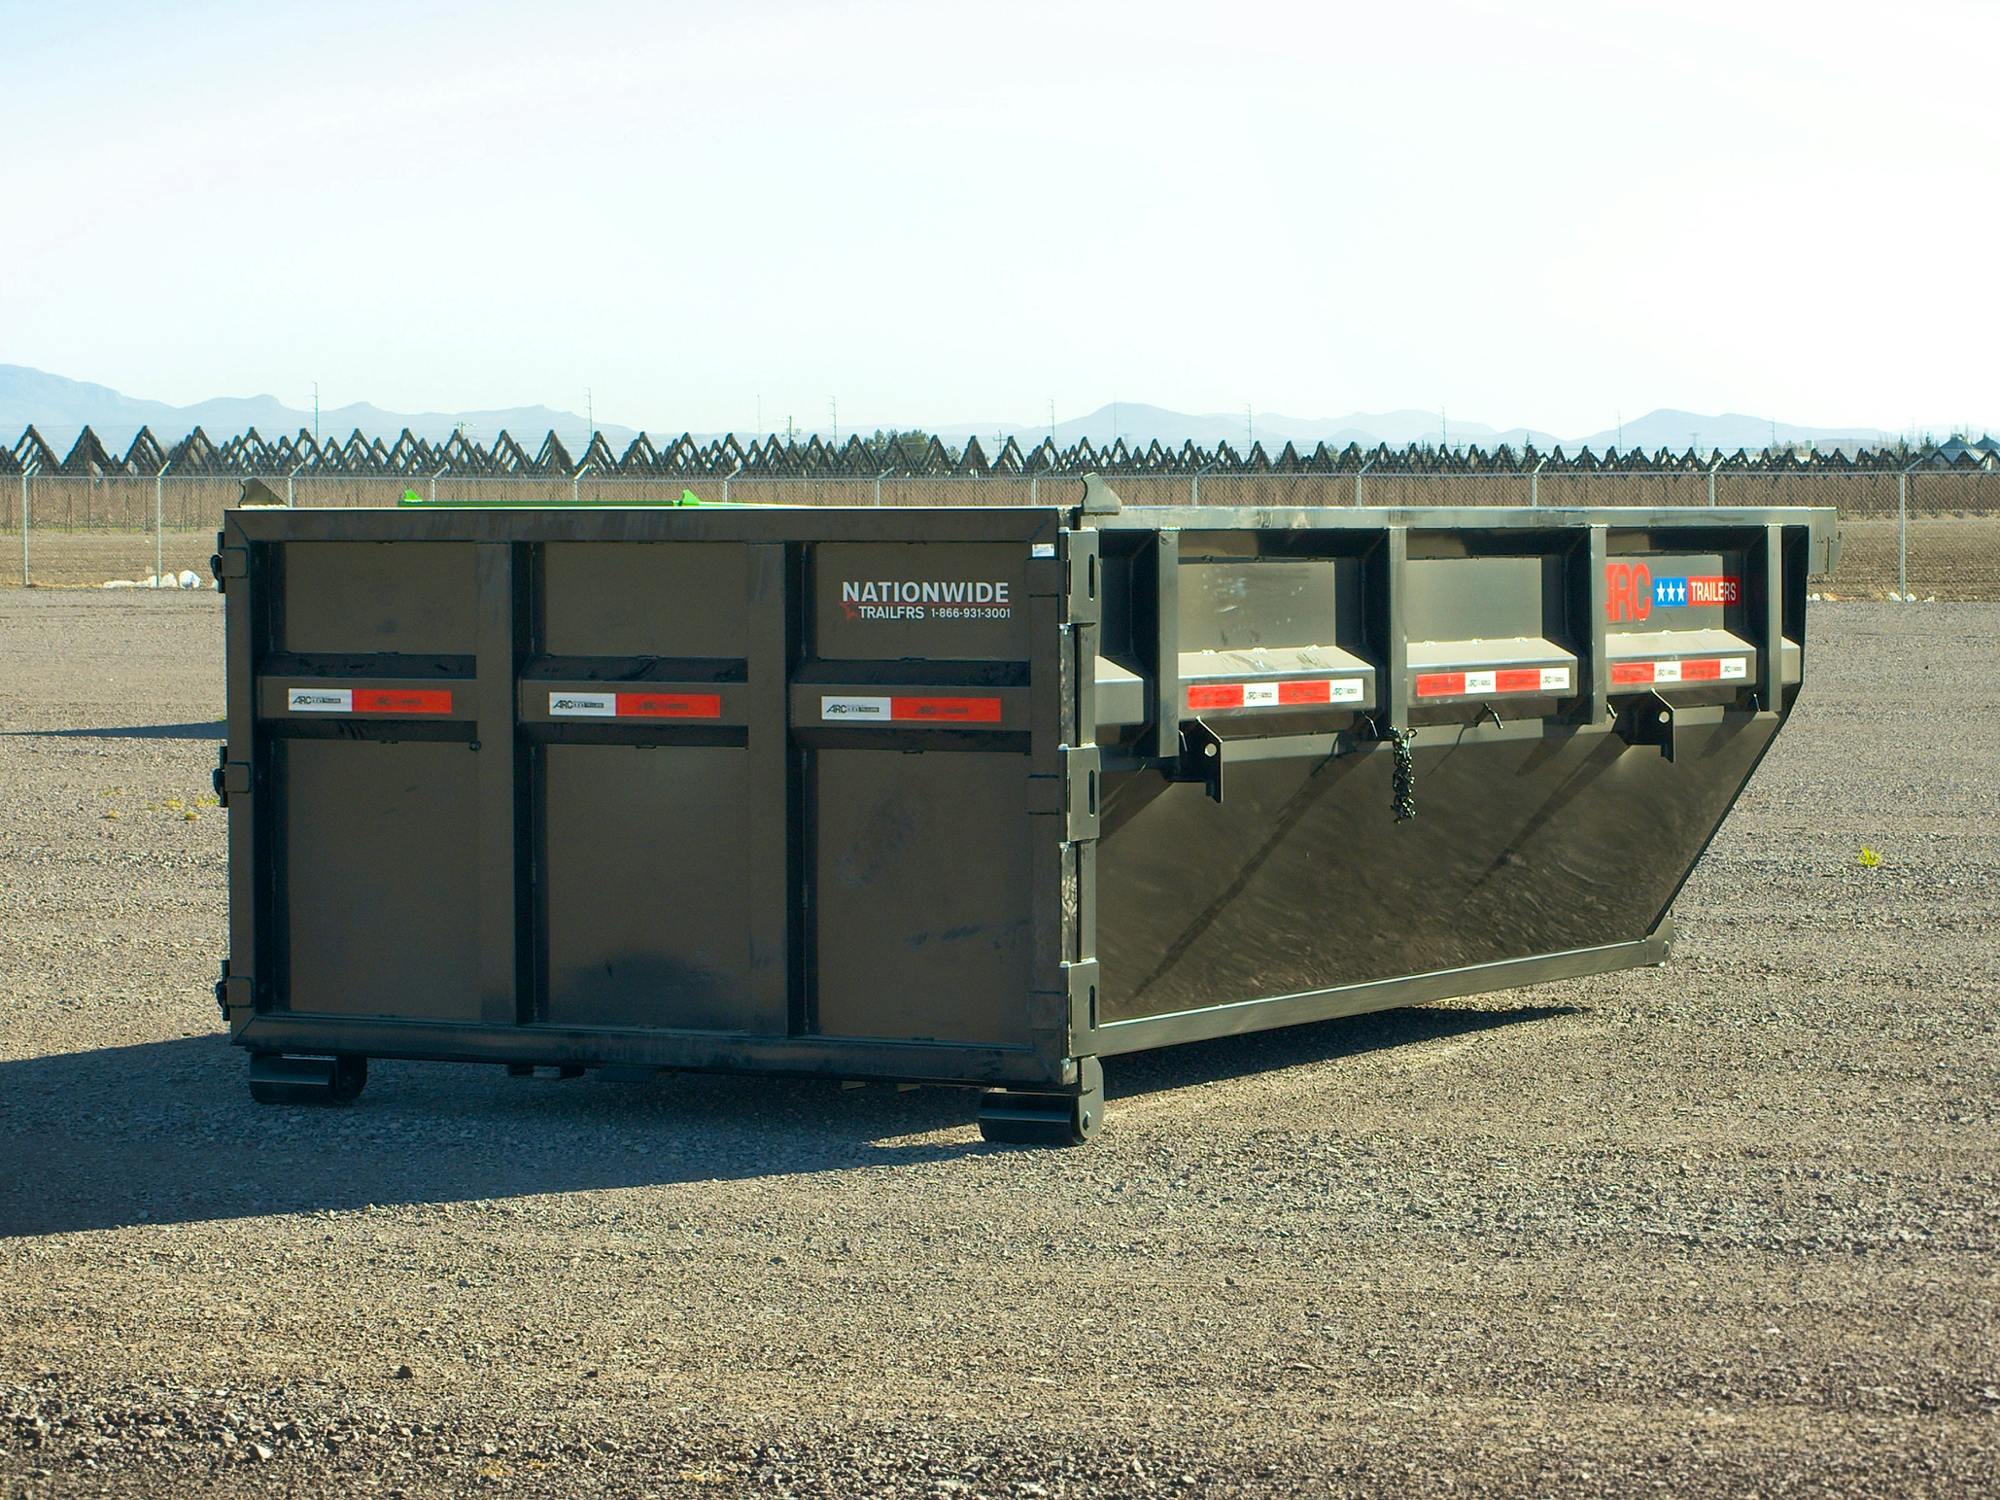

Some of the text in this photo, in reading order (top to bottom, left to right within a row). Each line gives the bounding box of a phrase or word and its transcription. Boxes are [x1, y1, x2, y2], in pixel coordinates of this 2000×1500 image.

[841, 581, 1009, 603] NATIONWIDE
[1690, 581, 1737, 602] TRAILERS
[931, 607, 1011, 619] 1-866-931-3001
